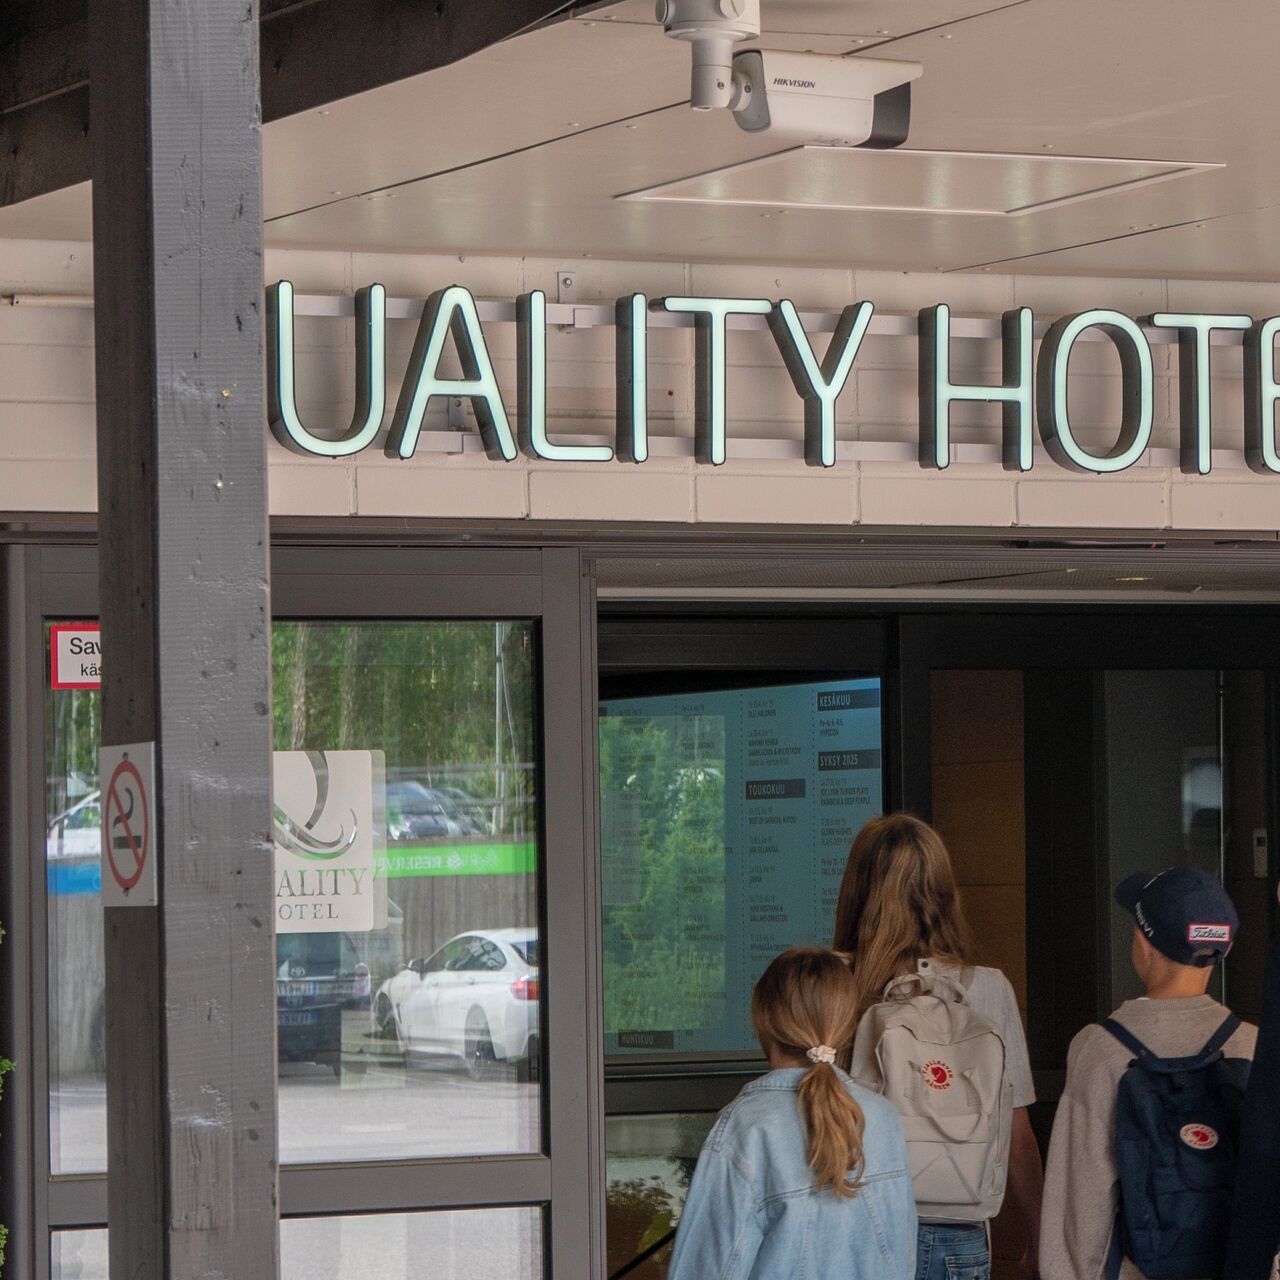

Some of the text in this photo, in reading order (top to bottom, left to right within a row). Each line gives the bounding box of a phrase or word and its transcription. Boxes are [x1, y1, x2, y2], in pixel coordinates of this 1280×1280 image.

[773, 78, 815, 88] HIKVISION
[266, 279, 876, 467] UALITY
[69, 637, 102, 655] Sav
[80, 663, 103, 677] käs
[819, 694, 851, 708] KESÄKUU
[820, 753, 858, 767] SYKSY 2025
[749, 784, 785, 796] TOUKOKUU
[275, 867, 368, 898] ALITY
[277, 902, 339, 921] OTEL
